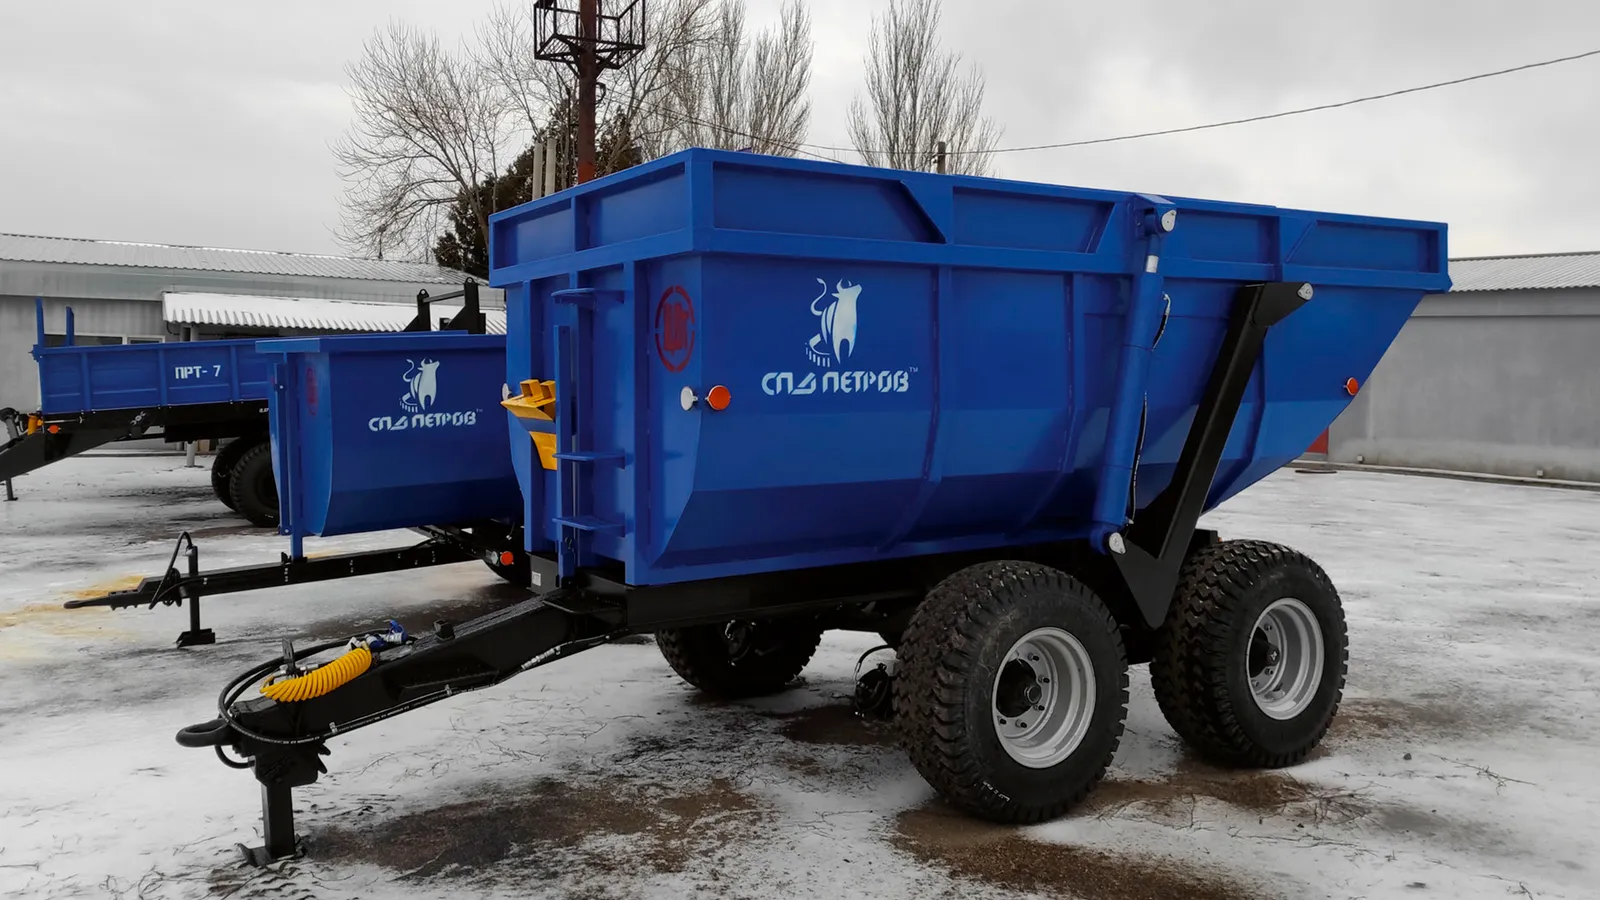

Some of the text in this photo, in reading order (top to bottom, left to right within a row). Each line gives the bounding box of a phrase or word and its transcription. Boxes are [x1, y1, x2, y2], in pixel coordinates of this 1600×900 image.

[212, 364, 221, 377] 7
[822, 370, 909, 394] ПЕТРОВ
[411, 410, 477, 429] ПЕТРОВ
